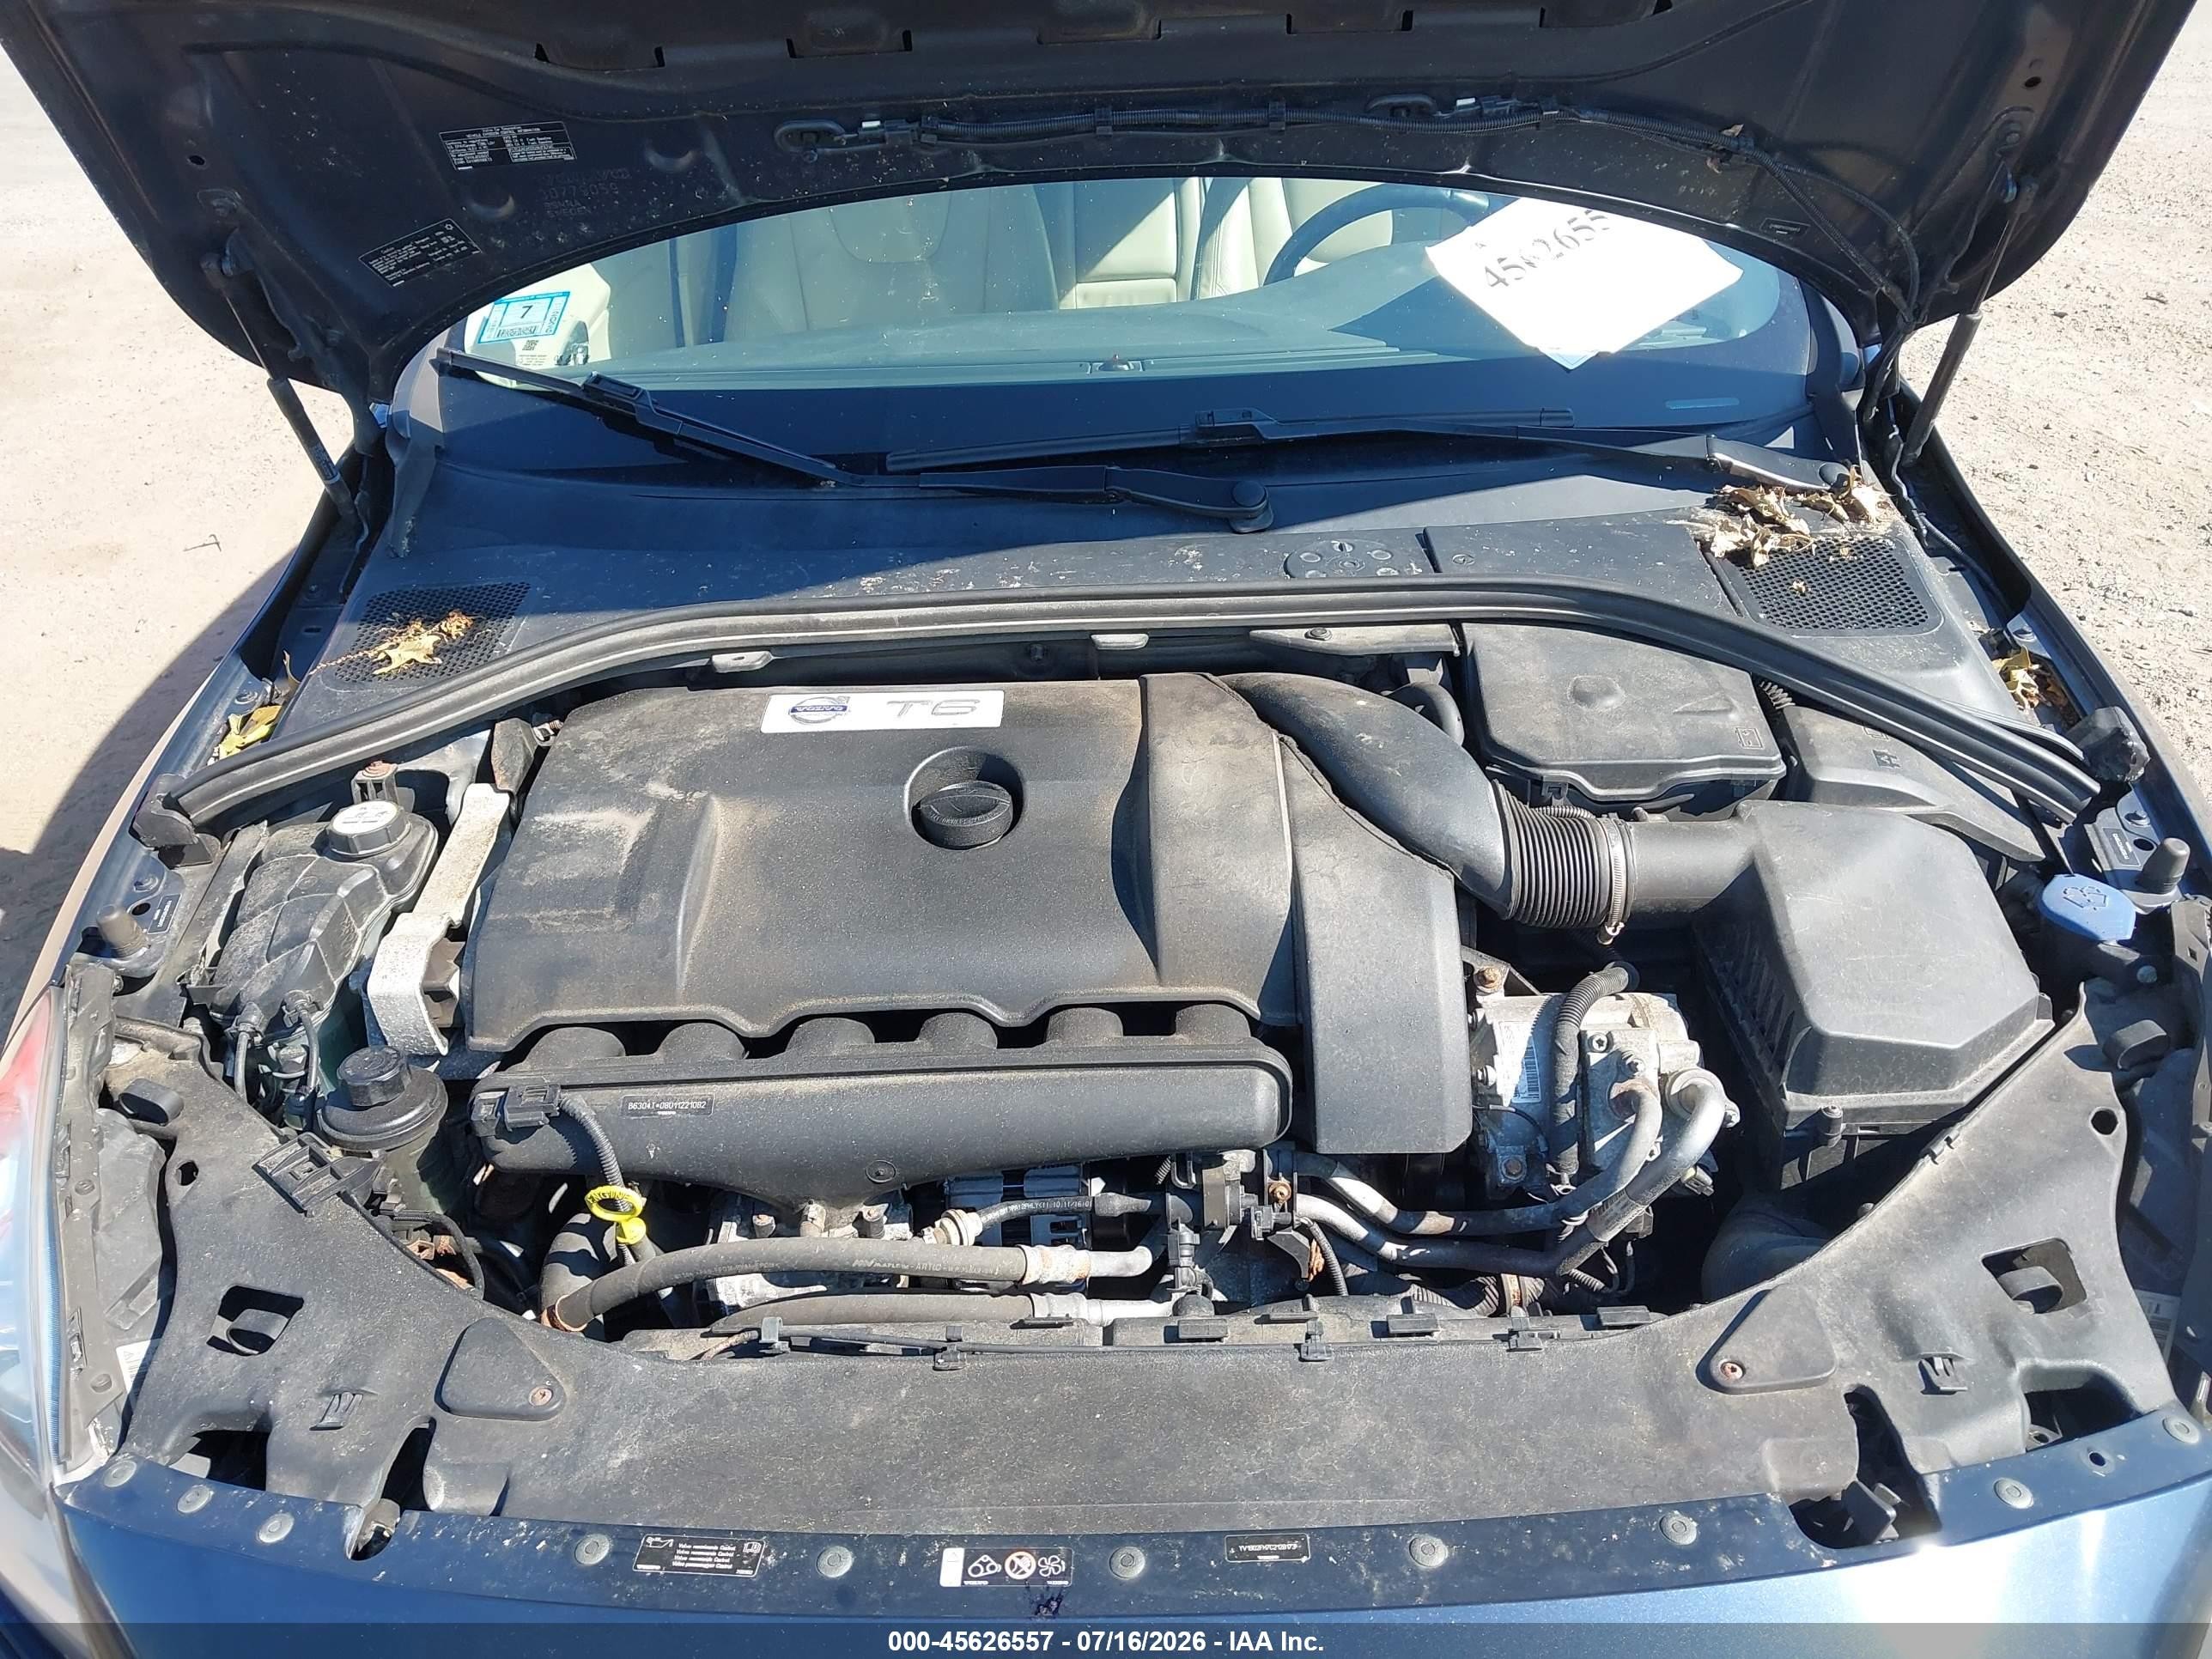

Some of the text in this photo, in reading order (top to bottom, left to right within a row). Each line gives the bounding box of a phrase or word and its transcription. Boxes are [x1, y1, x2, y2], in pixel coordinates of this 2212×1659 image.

[520, 305, 534, 319] 7
[795, 698, 981, 718] VOLVO T6
[586, 1190, 632, 1204] ENGINE
